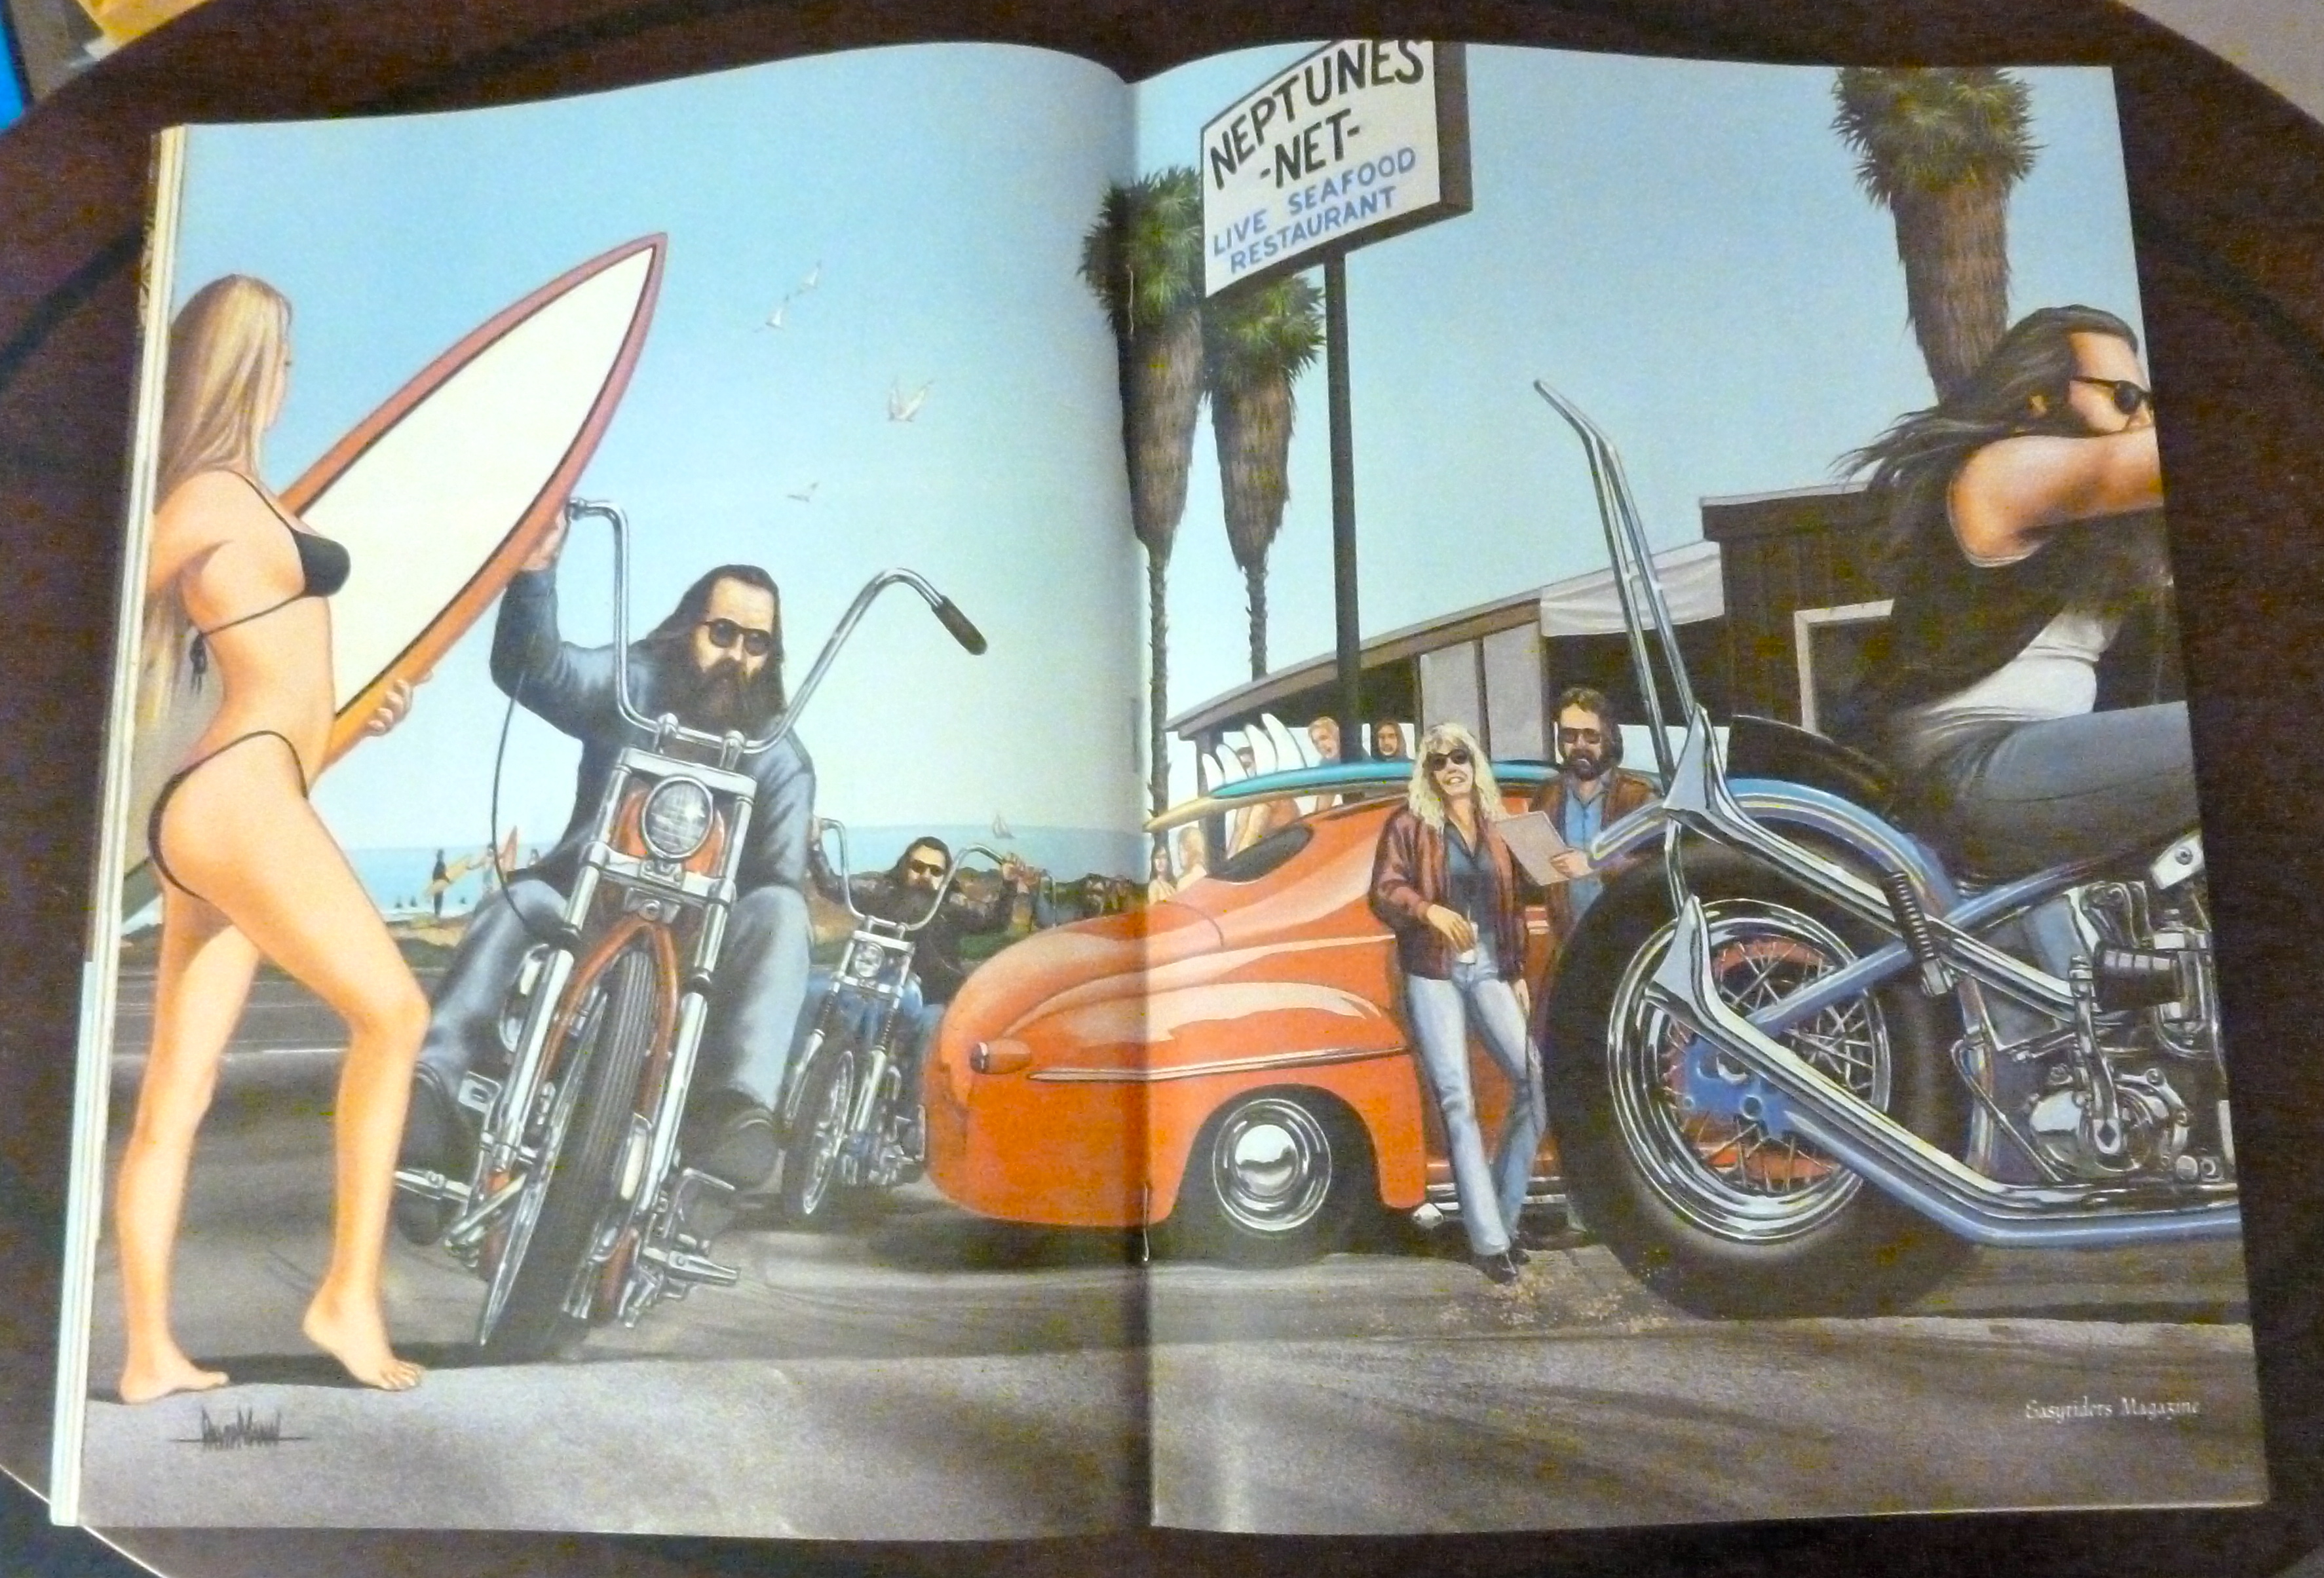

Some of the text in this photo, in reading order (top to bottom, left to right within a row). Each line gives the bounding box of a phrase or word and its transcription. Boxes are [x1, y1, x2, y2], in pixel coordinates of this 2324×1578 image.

[1210, 39, 1424, 190] NEPTUNES
[1213, 146, 1417, 256] LIVE SEAFOOD
[1229, 186, 1396, 274] RESTAURANT
